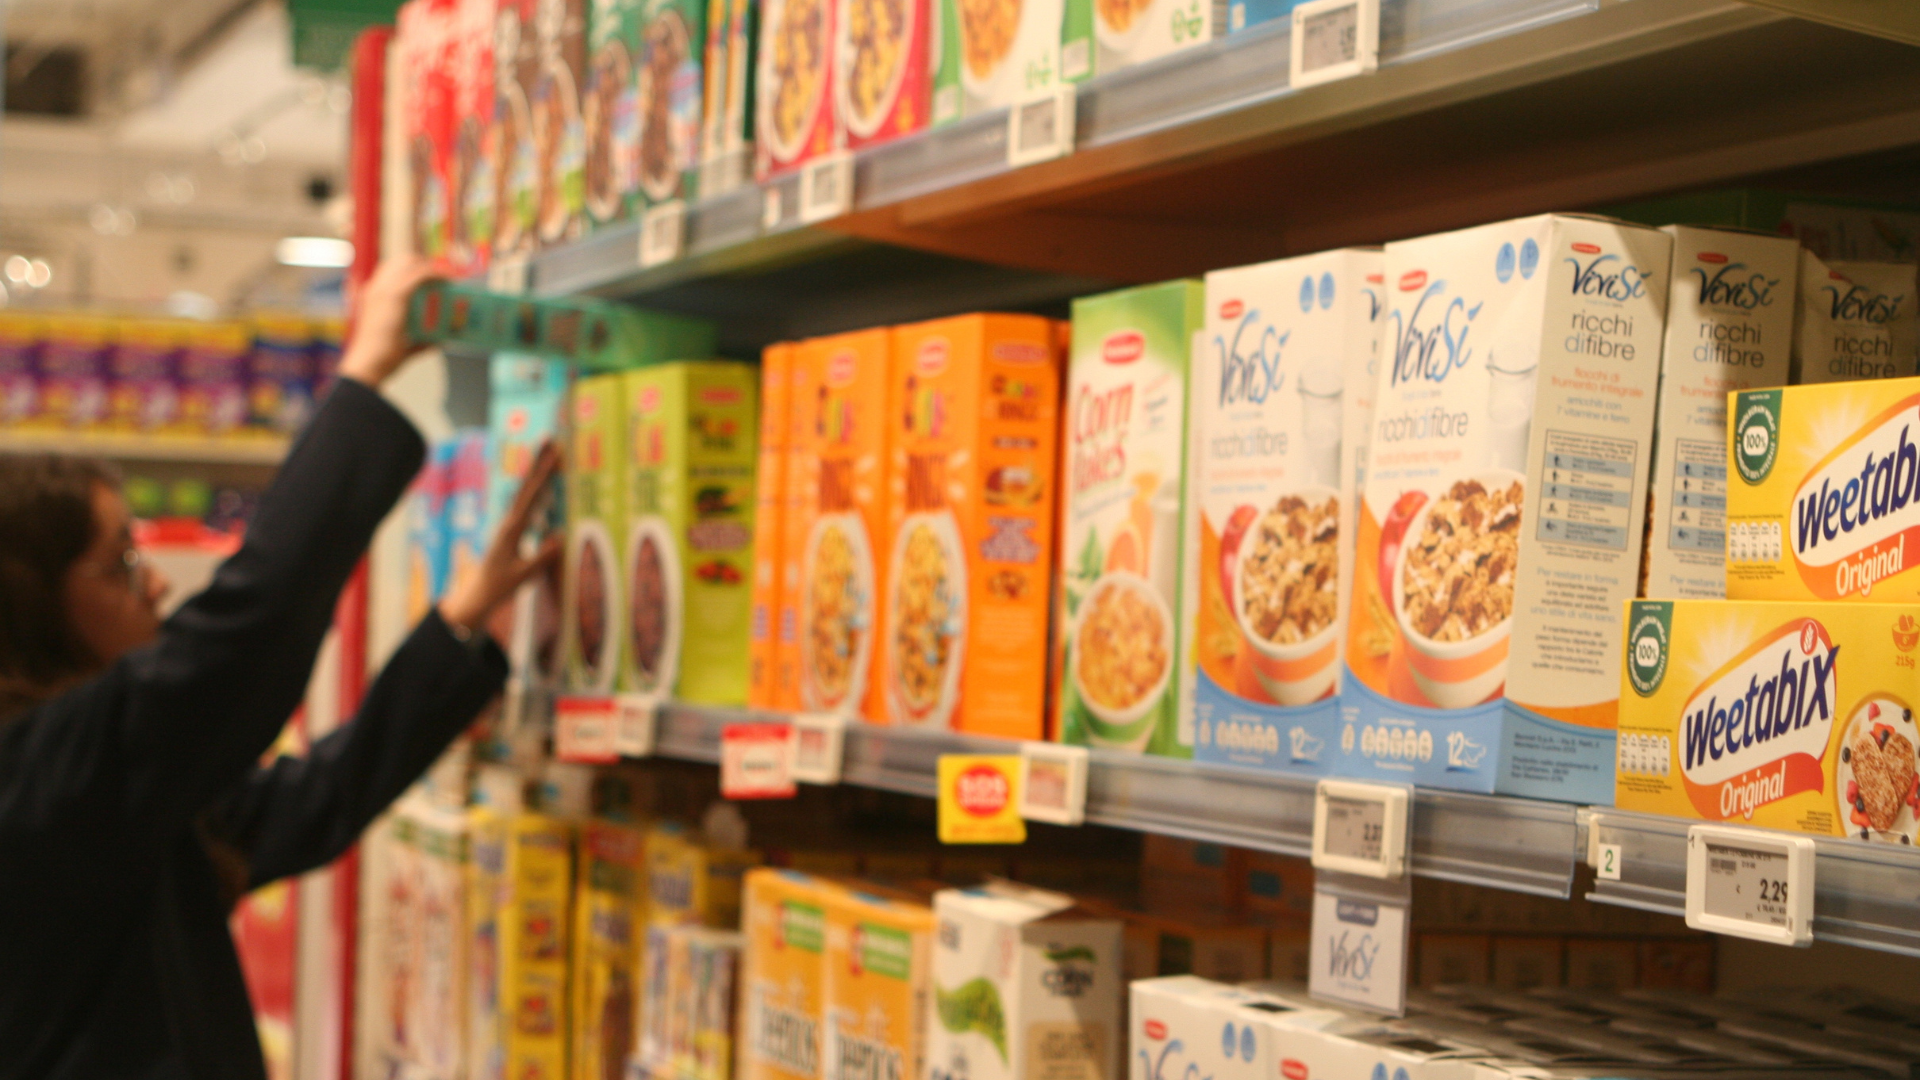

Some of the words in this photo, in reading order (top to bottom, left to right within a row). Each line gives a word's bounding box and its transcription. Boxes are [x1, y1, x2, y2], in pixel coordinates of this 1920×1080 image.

[1572, 310, 1633, 337] ricchi
[1700, 319, 1762, 343] ricchi
[1565, 333, 1635, 361] difibre
[1693, 342, 1764, 368] difibre
[1834, 333, 1894, 357] ricchi
[1074, 383, 1135, 445] Corn
[1746, 433, 1766, 450] 100%
[1836, 534, 1905, 597] Original
[1638, 644, 1658, 661] 100%
[1895, 655, 1915, 669] 215g
[1685, 645, 1841, 771] Weetabix
[1289, 726, 1305, 759] 12
[1446, 731, 1465, 766] 12
[1719, 760, 1786, 820] Original
[1604, 849, 1614, 873] 2
[1759, 877, 1788, 904] 2,29
